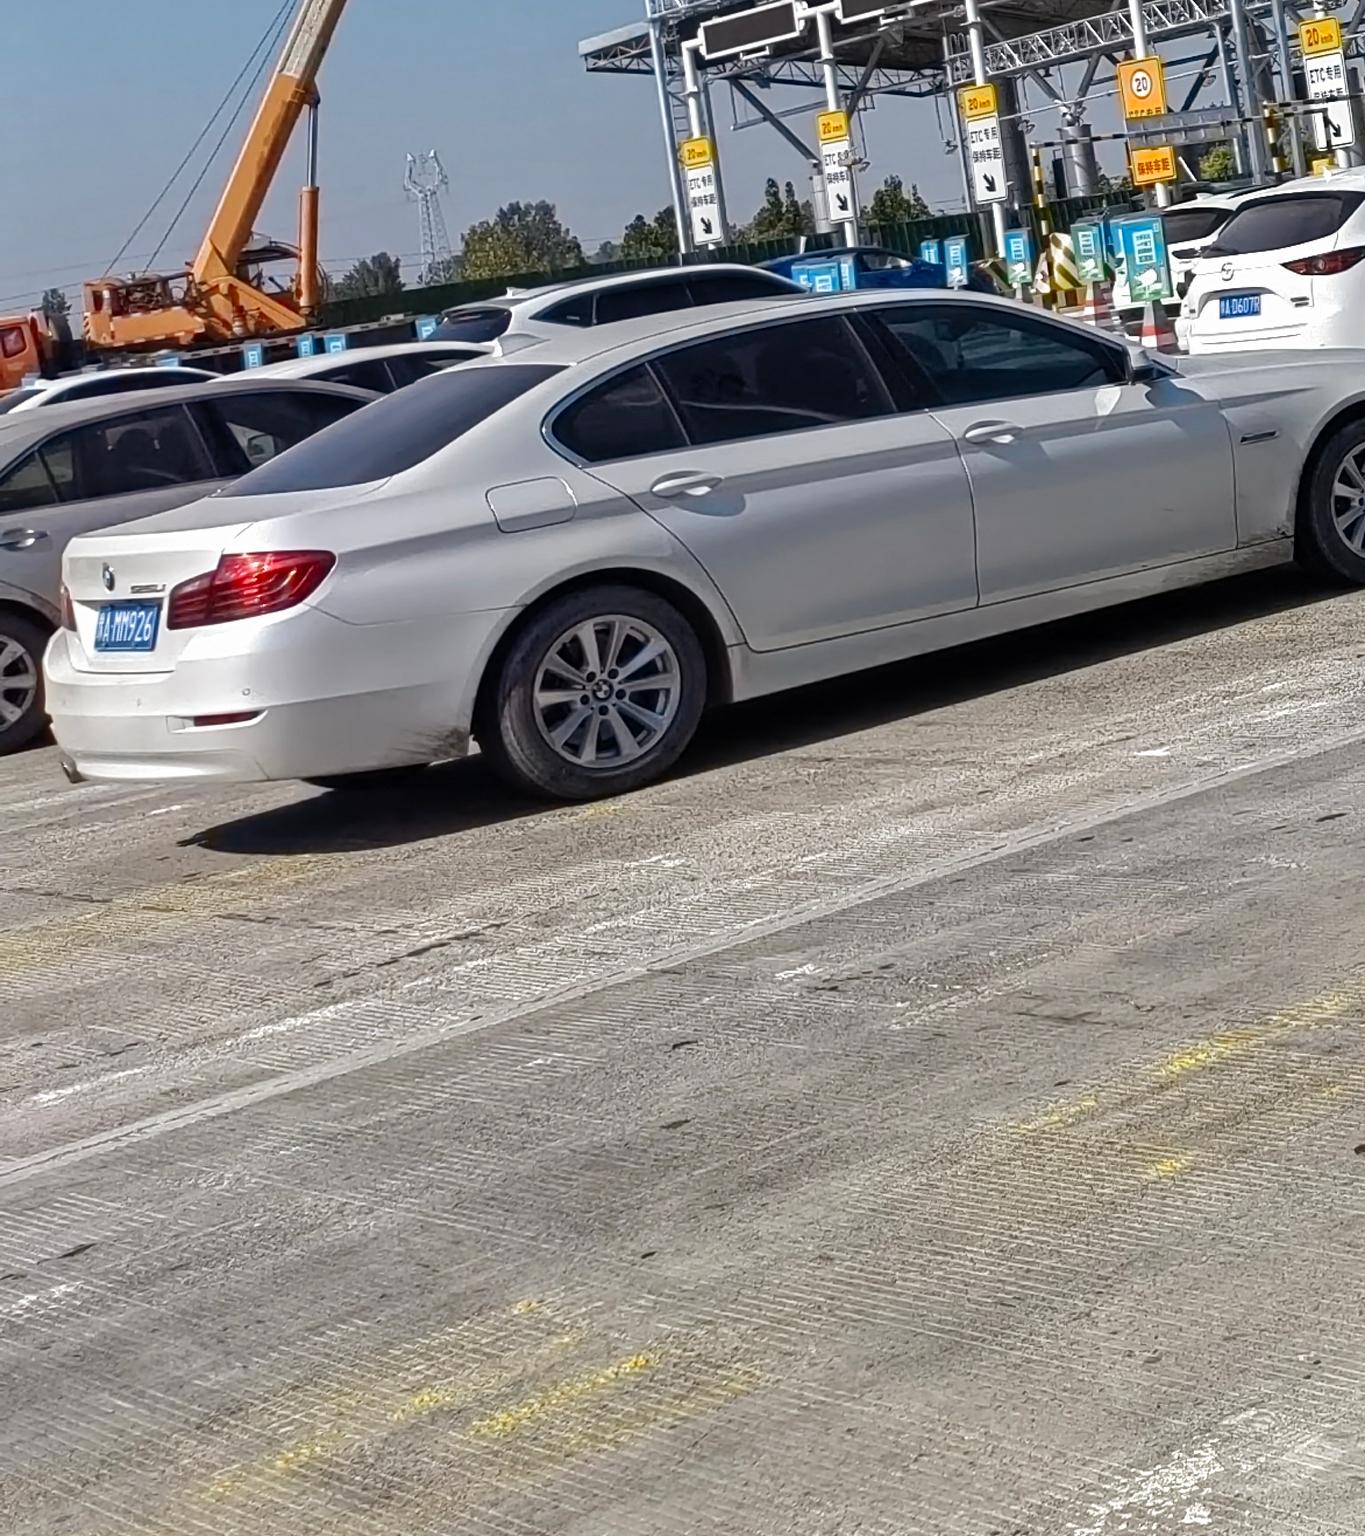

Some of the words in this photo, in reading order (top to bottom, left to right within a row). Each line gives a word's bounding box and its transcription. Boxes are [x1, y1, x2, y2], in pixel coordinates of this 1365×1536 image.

[1305, 27, 1319, 47] 20
[1134, 76, 1148, 92] 20
[967, 97, 978, 111] 20
[1137, 157, 1171, 175] 保持车距
